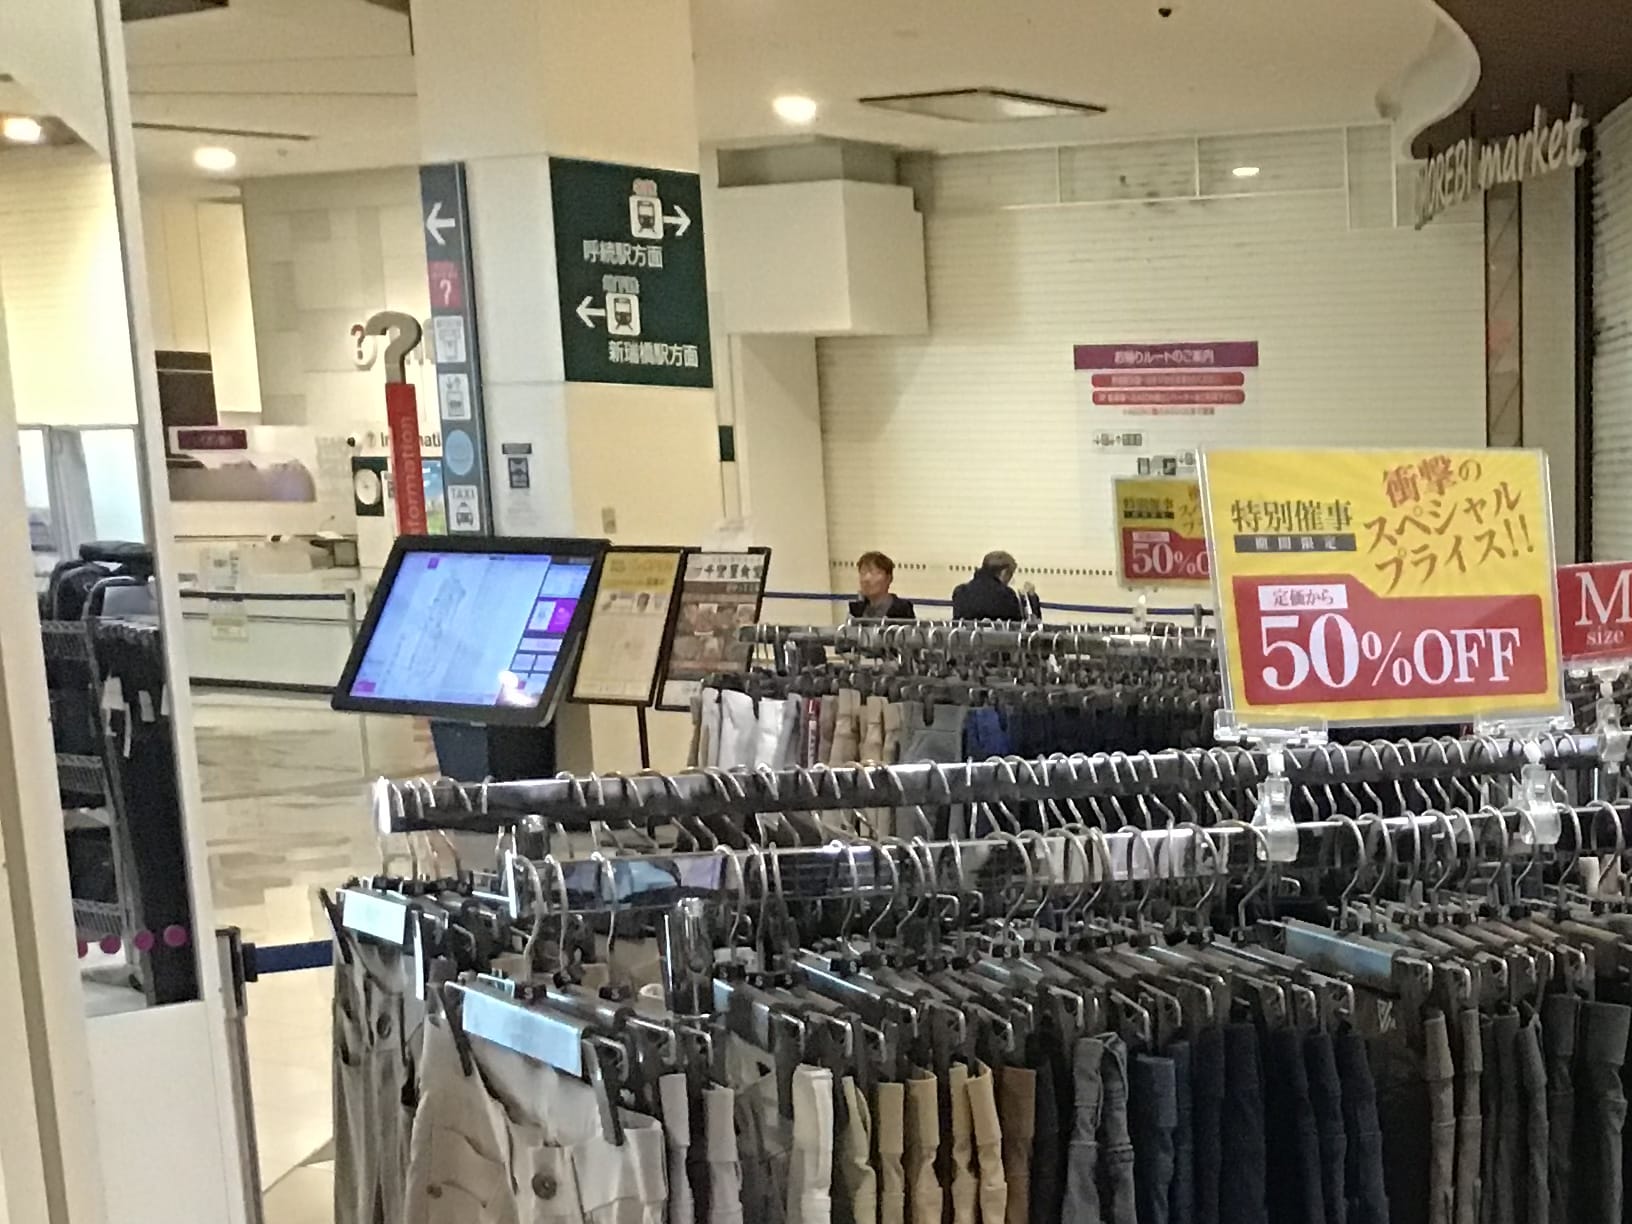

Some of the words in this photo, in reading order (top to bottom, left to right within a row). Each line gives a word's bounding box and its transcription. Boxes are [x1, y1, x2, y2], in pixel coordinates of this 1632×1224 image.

[1478, 101, 1589, 191] market
[1383, 454, 1482, 508] 衝撃の
[1232, 499, 1353, 533] 特別催事
[1363, 481, 1522, 554] スペシャル
[1273, 590, 1335, 607] 定価から
[1260, 613, 1522, 691] 50%OFF
[1586, 629, 1624, 646] size
